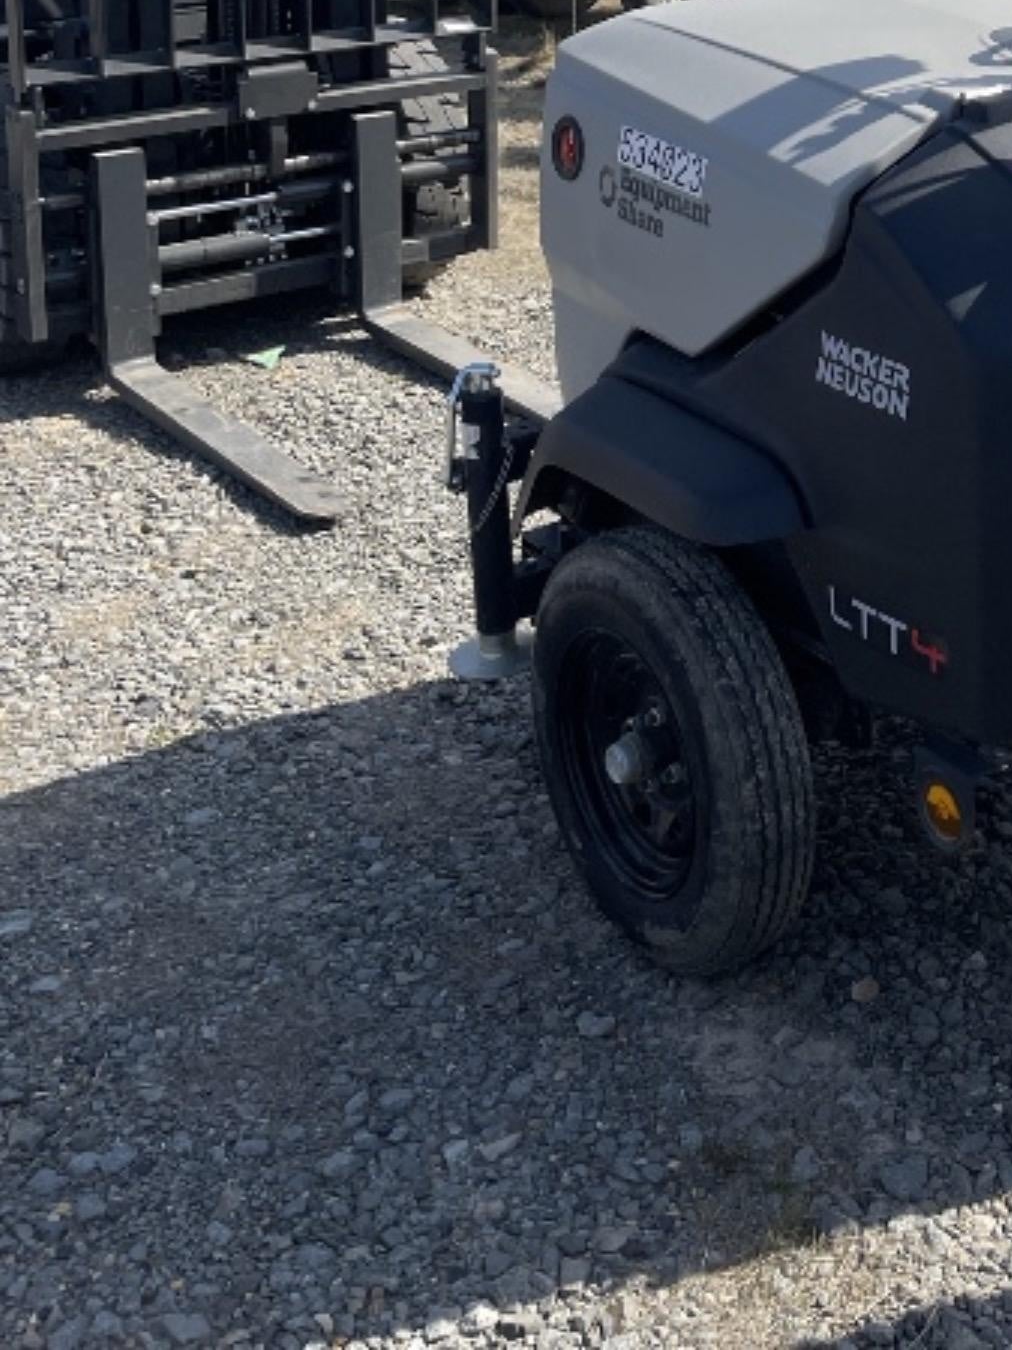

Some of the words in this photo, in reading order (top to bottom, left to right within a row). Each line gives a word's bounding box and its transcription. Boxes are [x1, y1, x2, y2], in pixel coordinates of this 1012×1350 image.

[619, 166, 713, 228] Equipment
[815, 356, 910, 421] NEUSON
[820, 330, 911, 393] WACKER
[827, 584, 948, 674] LTT4
